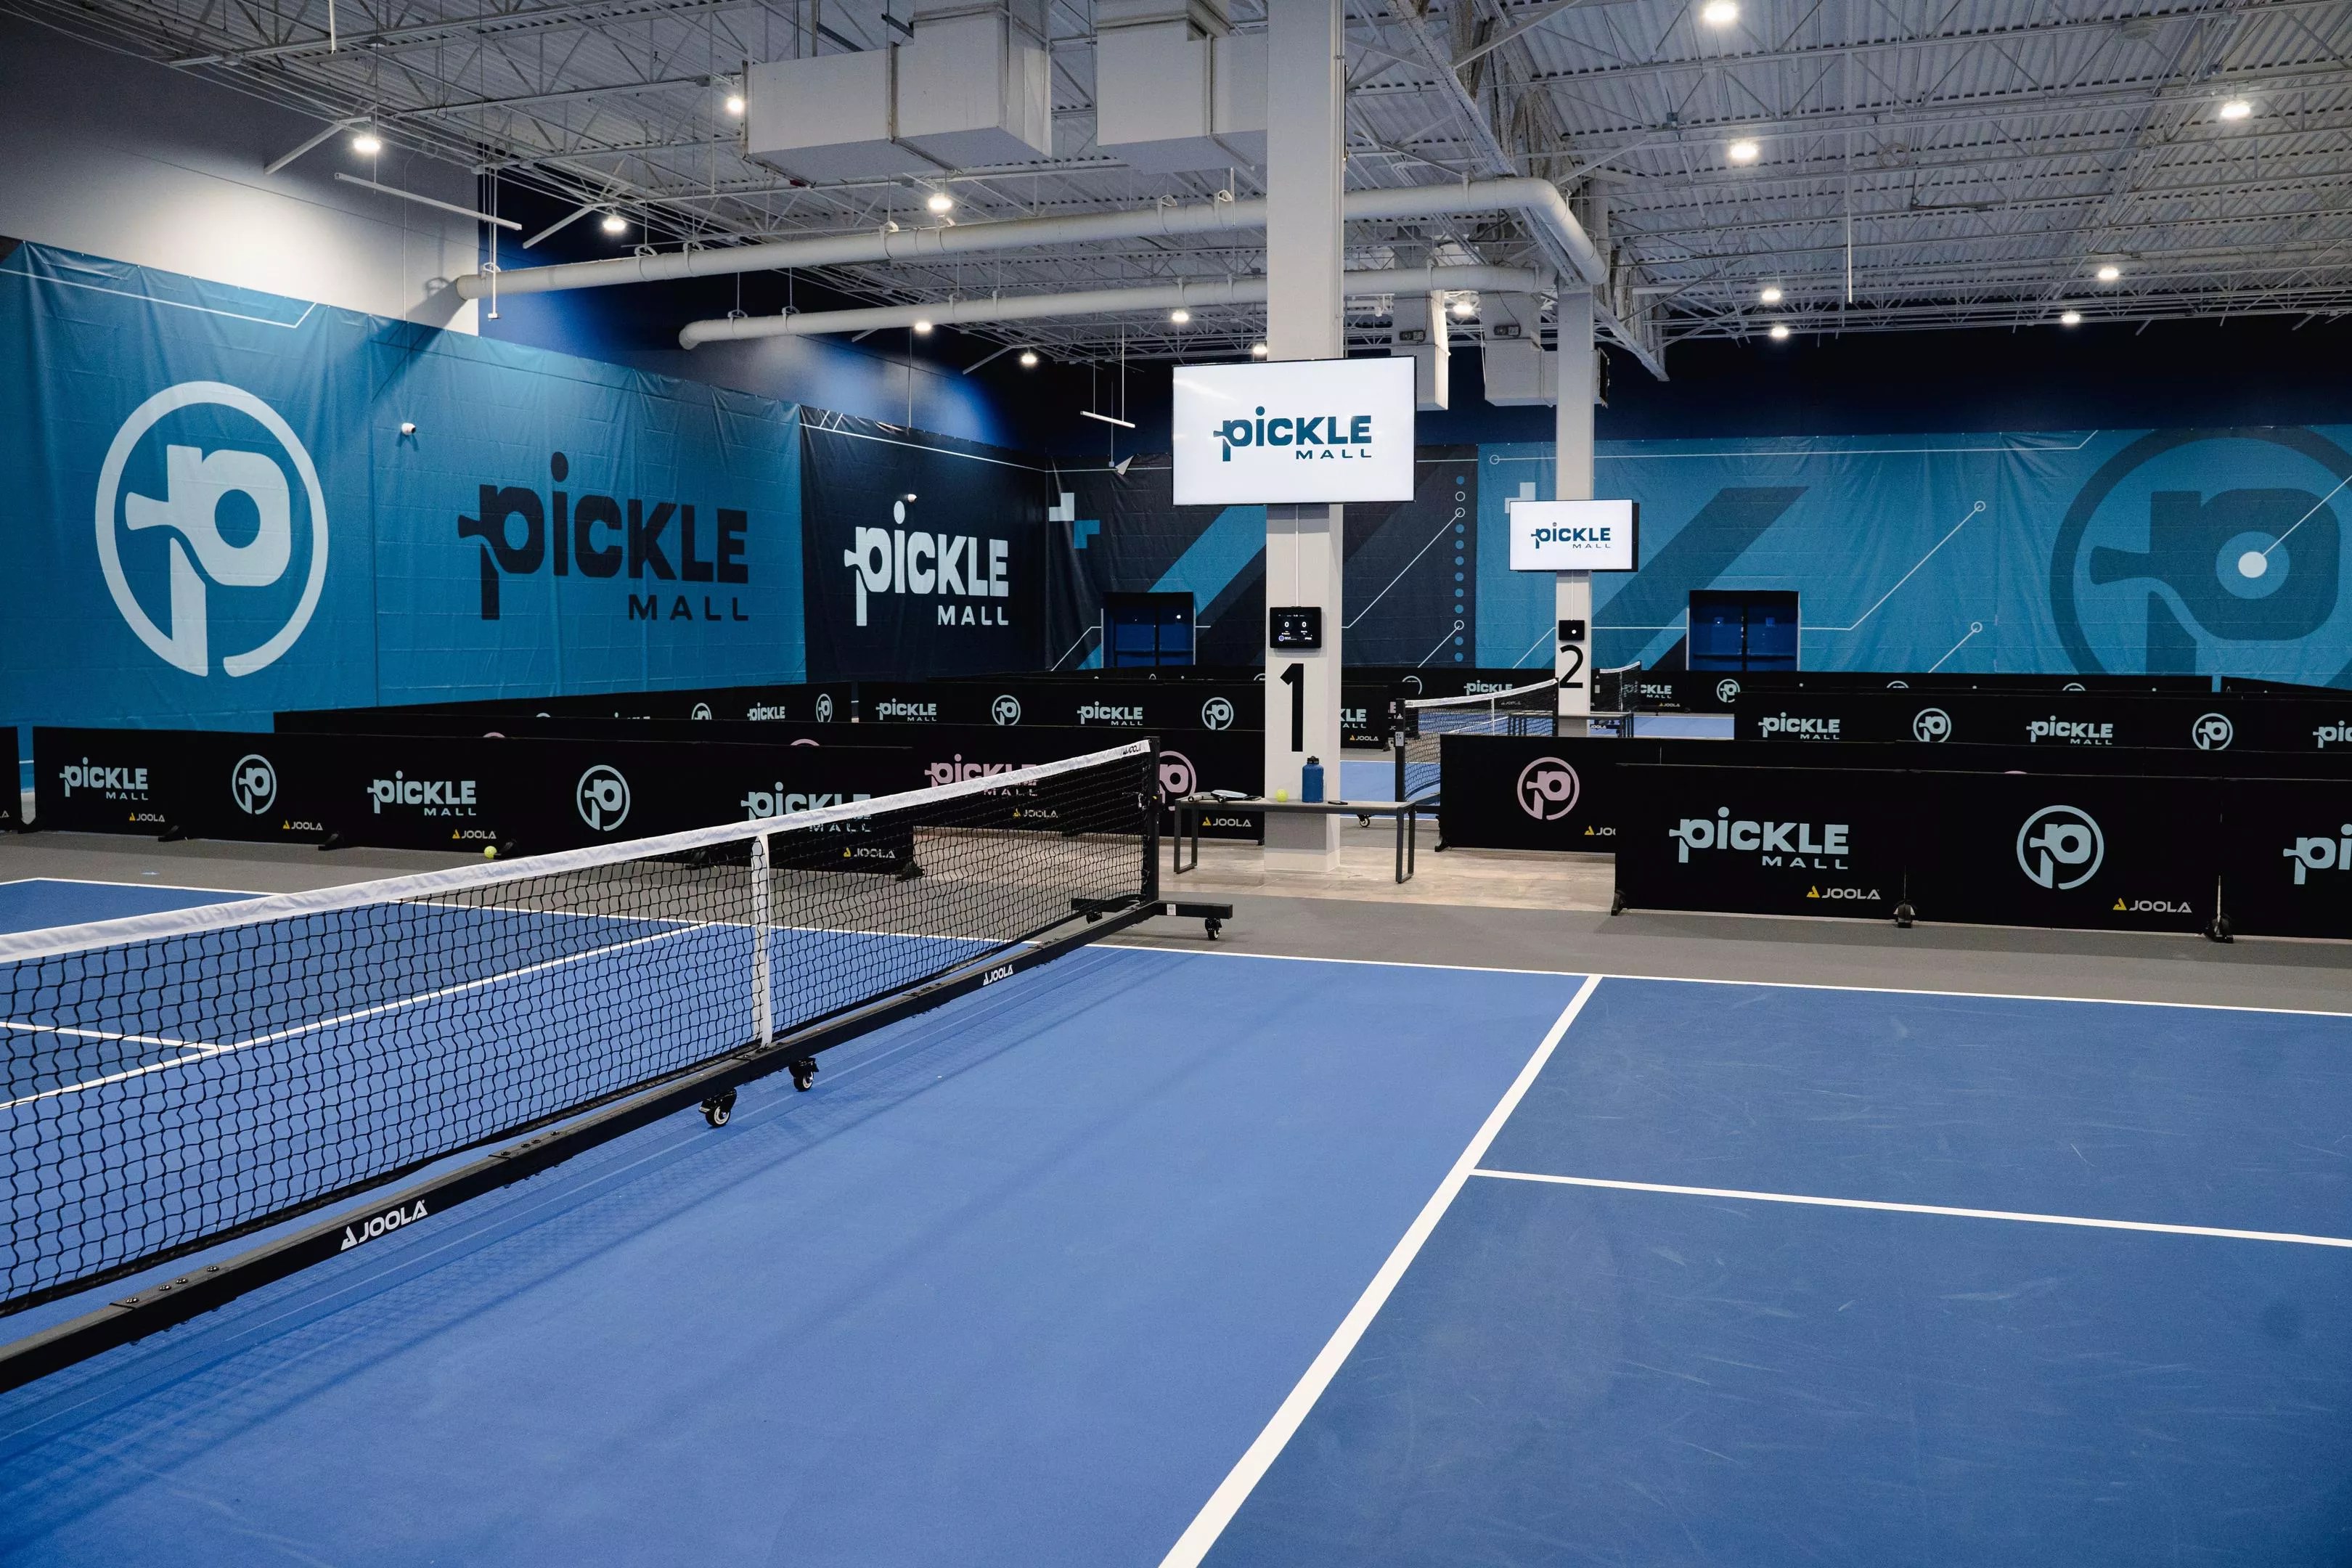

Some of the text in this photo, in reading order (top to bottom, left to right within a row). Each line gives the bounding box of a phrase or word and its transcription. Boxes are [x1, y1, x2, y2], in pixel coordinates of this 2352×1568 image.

[1296, 449, 1372, 460] MALL
[628, 594, 749, 621] MALL
[938, 605, 1008, 626] MALL
[1559, 645, 1584, 688] 2
[1280, 663, 1304, 752] 1
[106, 791, 149, 801] MALL
[984, 788, 1037, 796] MALL
[424, 807, 477, 816] MALL
[1023, 809, 1058, 818] JOOLA
[136, 814, 166, 822] JOOLA
[1213, 818, 1252, 828] JOOLA
[291, 821, 324, 830] JOOLA
[809, 823, 872, 833] MALL
[461, 830, 497, 839] JOOLA
[853, 848, 896, 859] JOOLA
[1762, 855, 1849, 870] MALL
[1821, 888, 1882, 900] JOOLA
[2128, 900, 2193, 913] JOOLA
[989, 964, 1013, 983] JOOLA
[358, 1199, 428, 1244] JOOLA
